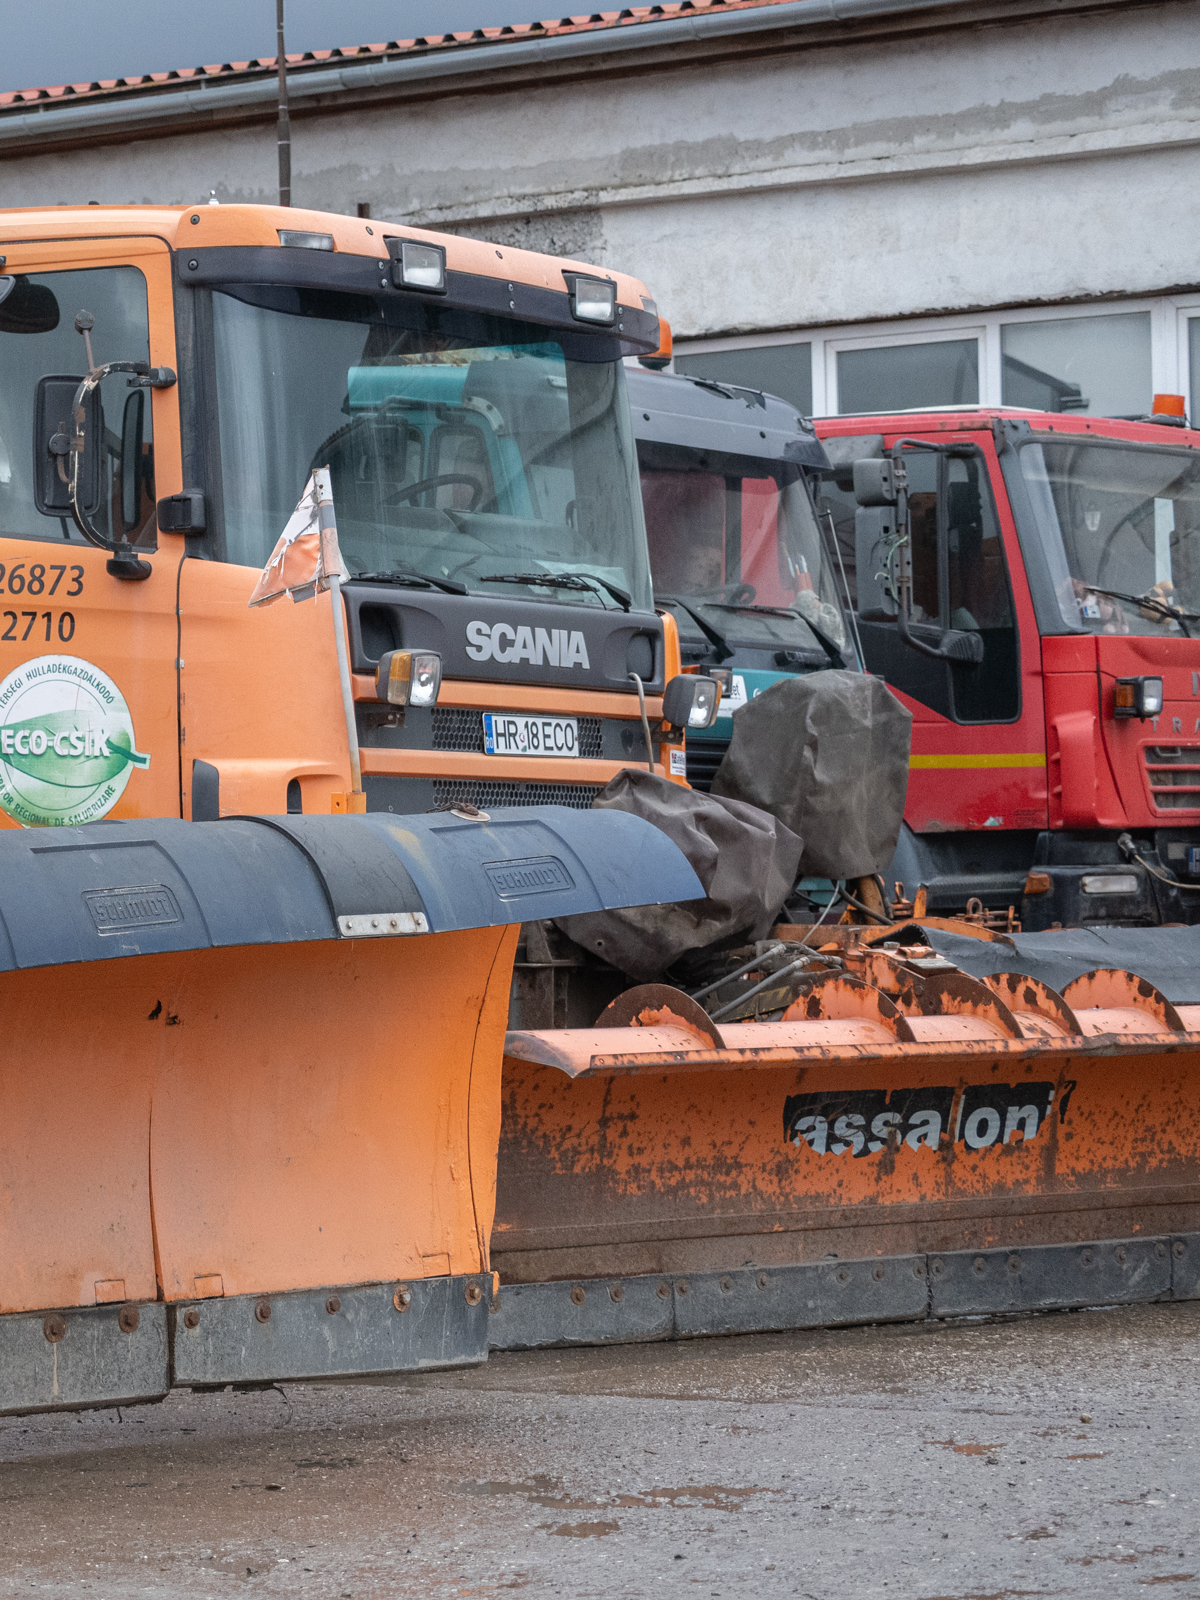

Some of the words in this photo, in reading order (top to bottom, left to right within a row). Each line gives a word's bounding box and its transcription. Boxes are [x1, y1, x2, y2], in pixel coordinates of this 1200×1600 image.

[465, 620, 591, 670] SCANIA
[25, 662, 116, 704] HULLADÉKGAZDÁLKODÓ
[494, 719, 519, 750] HR
[524, 720, 540, 750] 18
[542, 721, 575, 752] ECO
[13, 803, 50, 826] REGIONAL
[54, 819, 66, 827] DE
[69, 785, 116, 825] SALUBRIZARE
[492, 867, 562, 891] SCHMIDT
[94, 898, 170, 922] SCHMIDT
